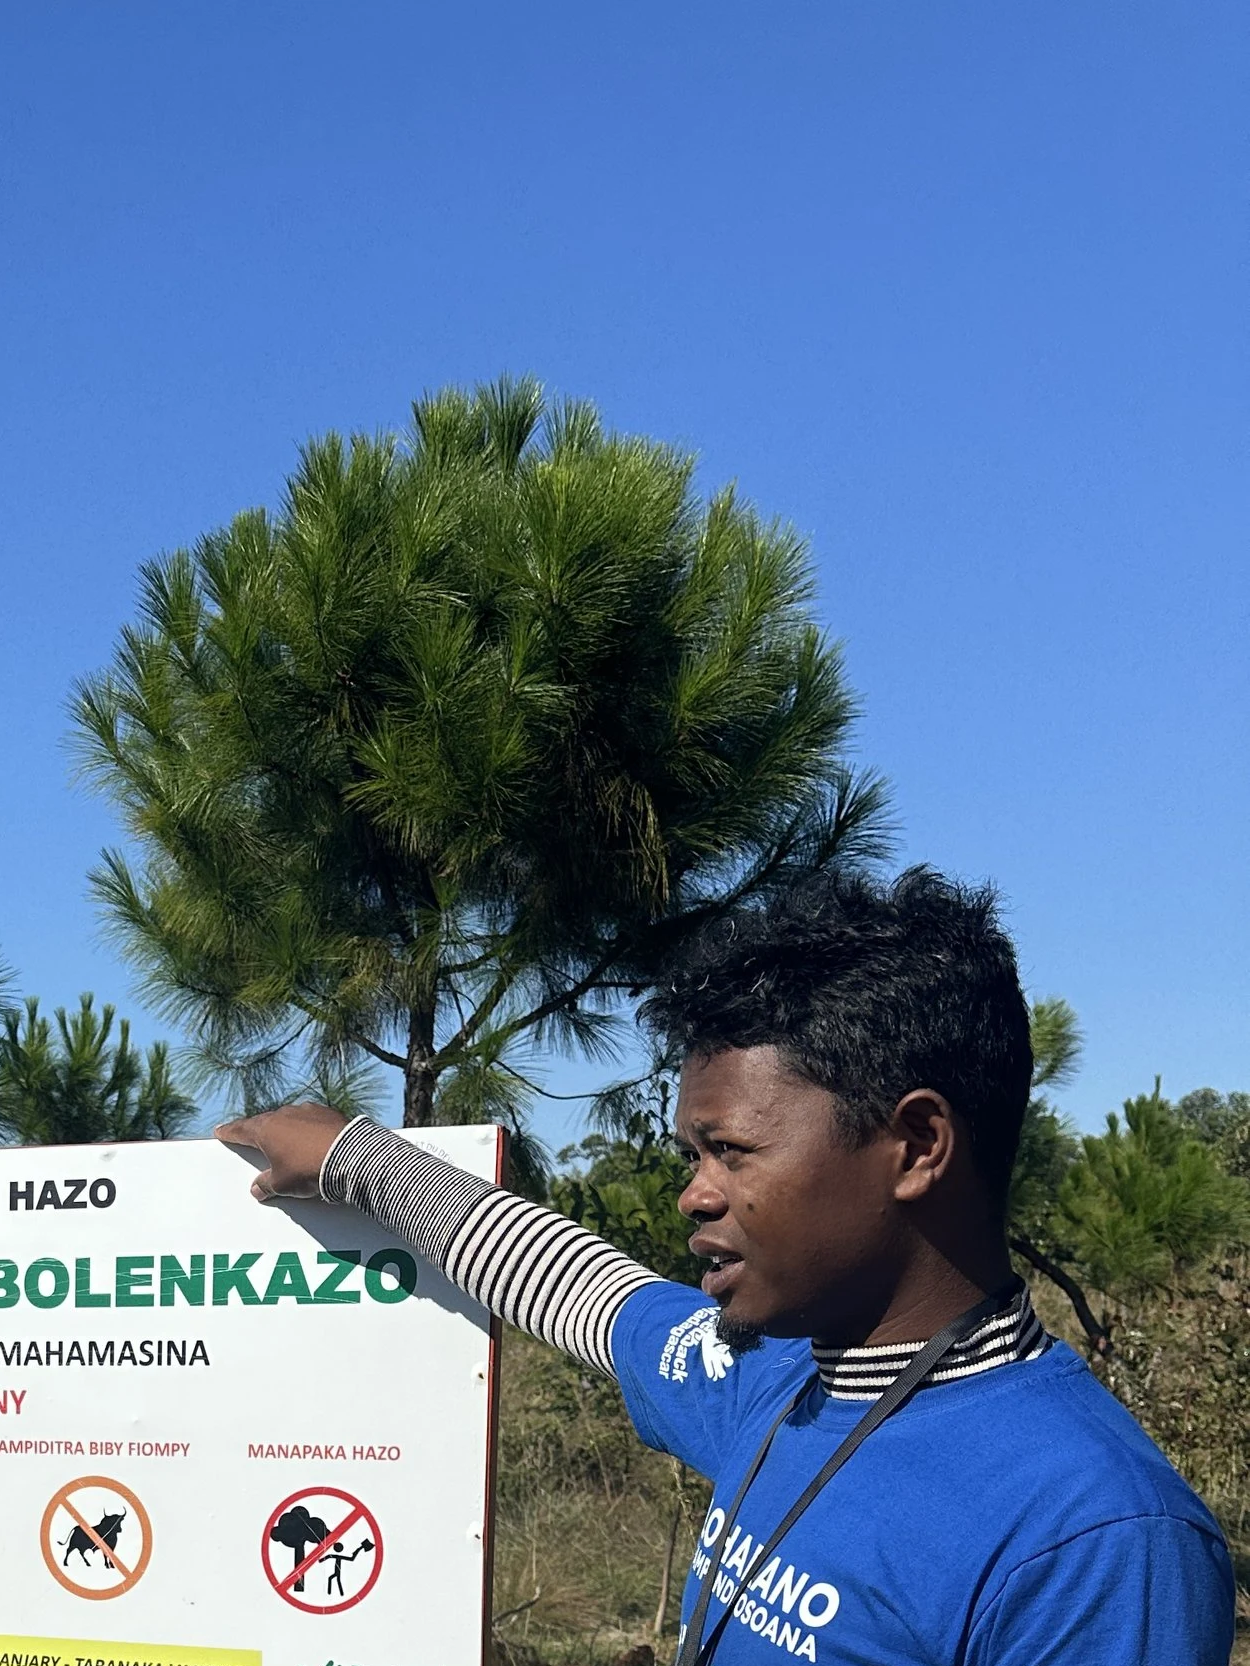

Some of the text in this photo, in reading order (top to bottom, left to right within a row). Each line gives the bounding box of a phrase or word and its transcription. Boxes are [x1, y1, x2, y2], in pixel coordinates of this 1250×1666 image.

[10, 1178, 116, 1211] HAZO
[90, 1442, 123, 1455] BIBY
[129, 1443, 190, 1456] FIOMPY
[249, 1444, 400, 1460] MANAPAKA HAZO
